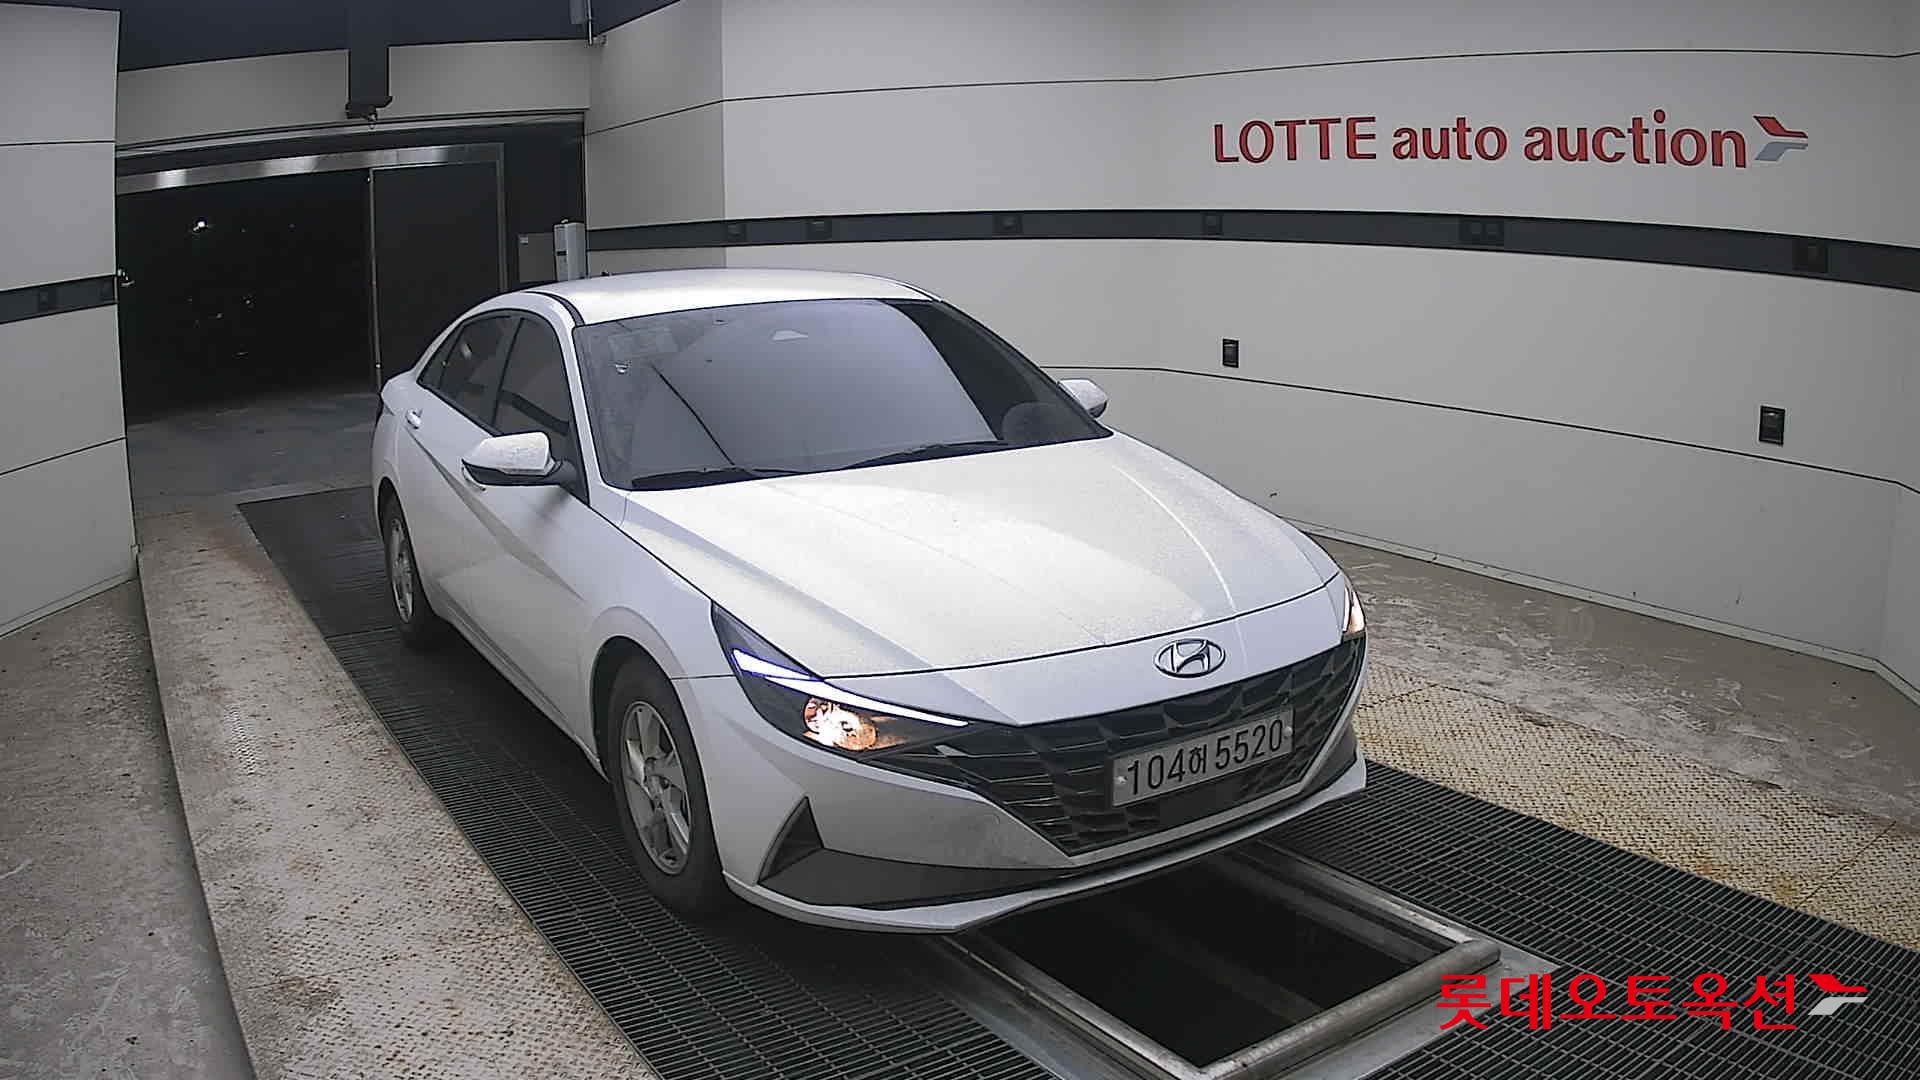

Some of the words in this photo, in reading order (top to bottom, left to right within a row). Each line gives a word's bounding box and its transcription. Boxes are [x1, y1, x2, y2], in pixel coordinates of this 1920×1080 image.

[1213, 117, 1377, 163] LOTTE
[1392, 117, 1508, 161] auto
[1523, 109, 1747, 168] auction
[1215, 719, 1284, 770] 5520
